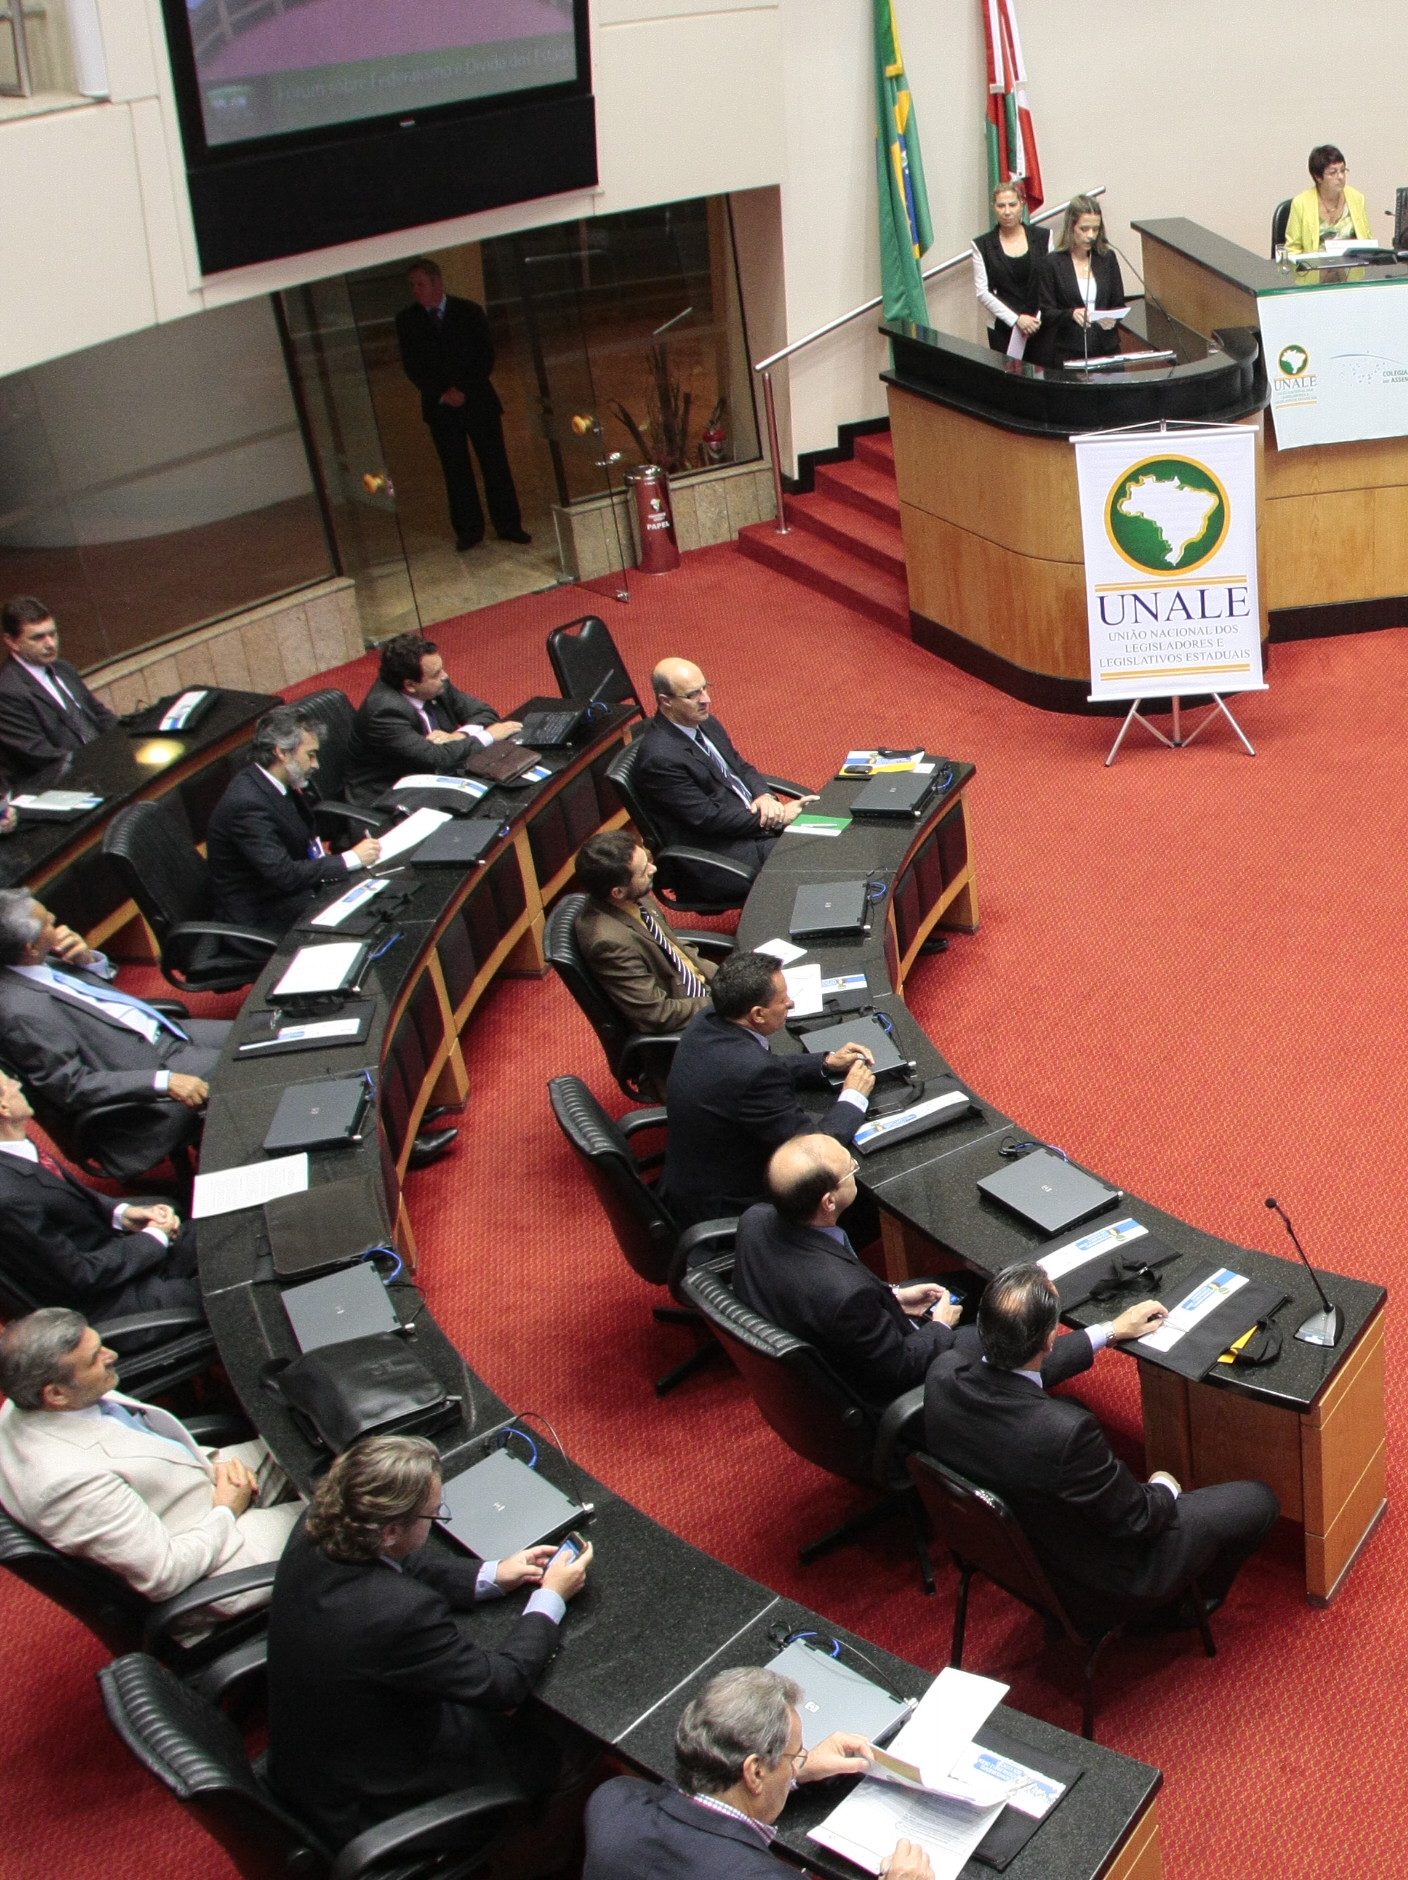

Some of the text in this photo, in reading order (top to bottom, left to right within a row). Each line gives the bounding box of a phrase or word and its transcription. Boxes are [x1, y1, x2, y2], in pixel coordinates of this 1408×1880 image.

[1274, 376, 1317, 392] UNALE
[646, 521, 670, 530] PAPEL
[1098, 586, 1251, 626] UNALE
[1108, 624, 1239, 642] UNIÃO NACIONAL DOS
[1125, 637, 1224, 653] LEGISLADORES E
[1099, 649, 1251, 668] LEGISLATIVOS ESTADUAIS
